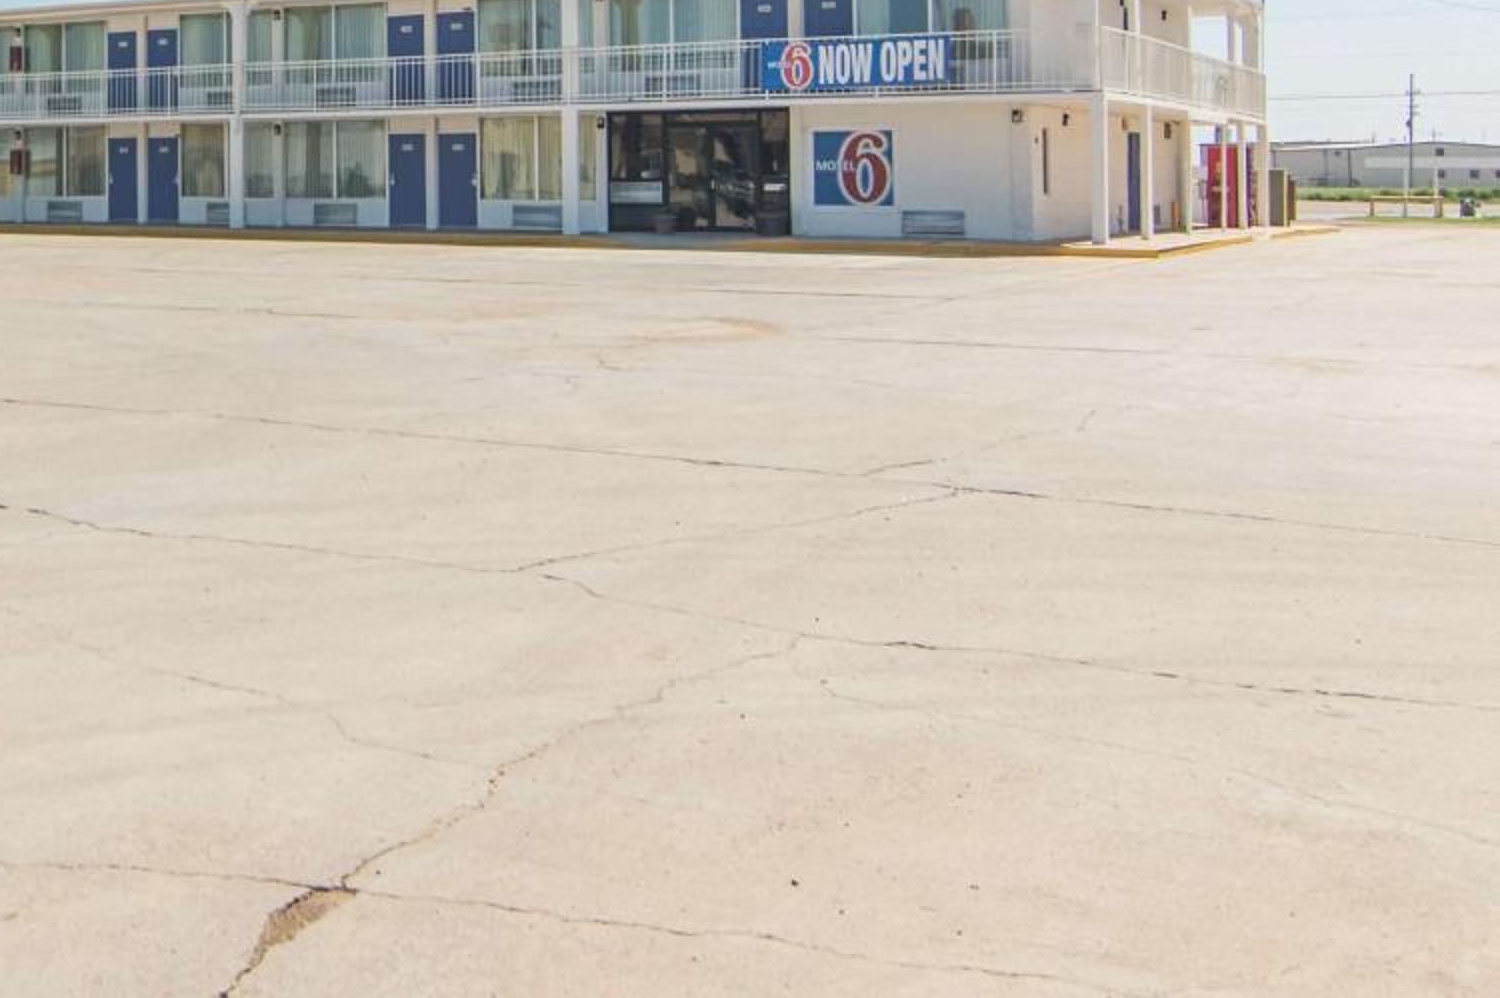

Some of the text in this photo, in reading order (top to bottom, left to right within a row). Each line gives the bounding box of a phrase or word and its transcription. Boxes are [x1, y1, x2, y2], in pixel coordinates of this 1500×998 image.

[782, 38, 945, 89] 6 NOW OPEN
[815, 132, 888, 203] MOEL 6
